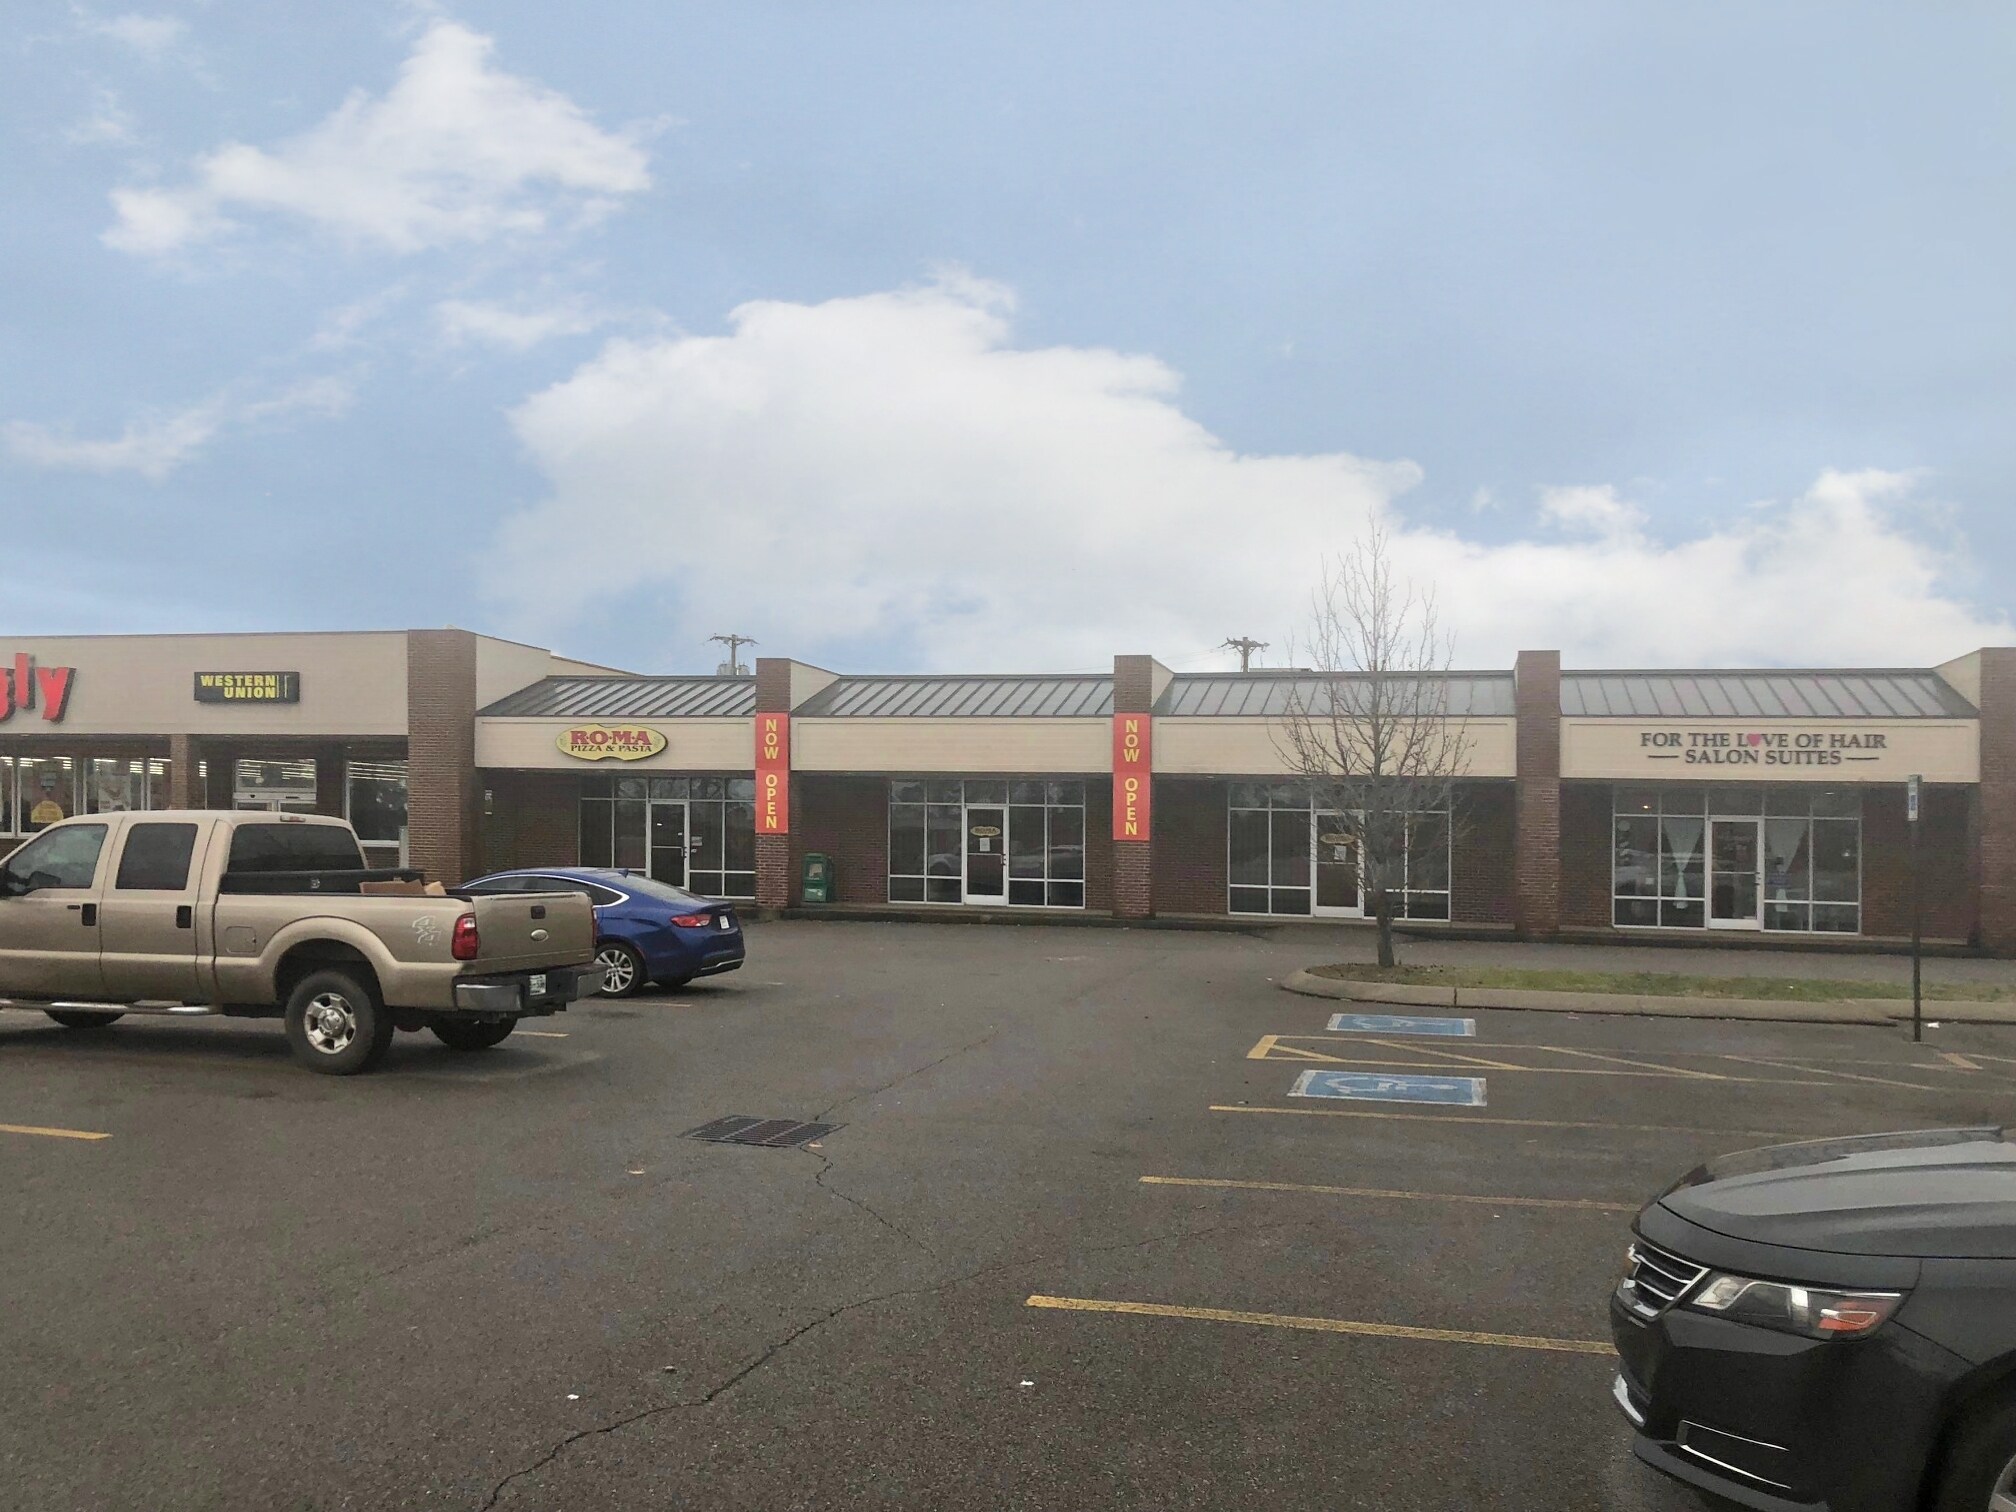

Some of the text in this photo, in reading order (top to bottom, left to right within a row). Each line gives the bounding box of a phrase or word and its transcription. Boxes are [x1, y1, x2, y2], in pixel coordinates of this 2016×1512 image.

[200, 675, 276, 686] WESTERN
[224, 687, 276, 698] UNION
[1640, 732, 1683, 747] FOR
[1688, 733, 1730, 747] THE
[1795, 734, 1824, 748] OF
[1829, 734, 1887, 748] HAIR
[1685, 749, 1841, 765] SALON SUITES
[764, 719, 779, 829] NOW OPEN
[1123, 720, 1140, 835] NOW OPEN
